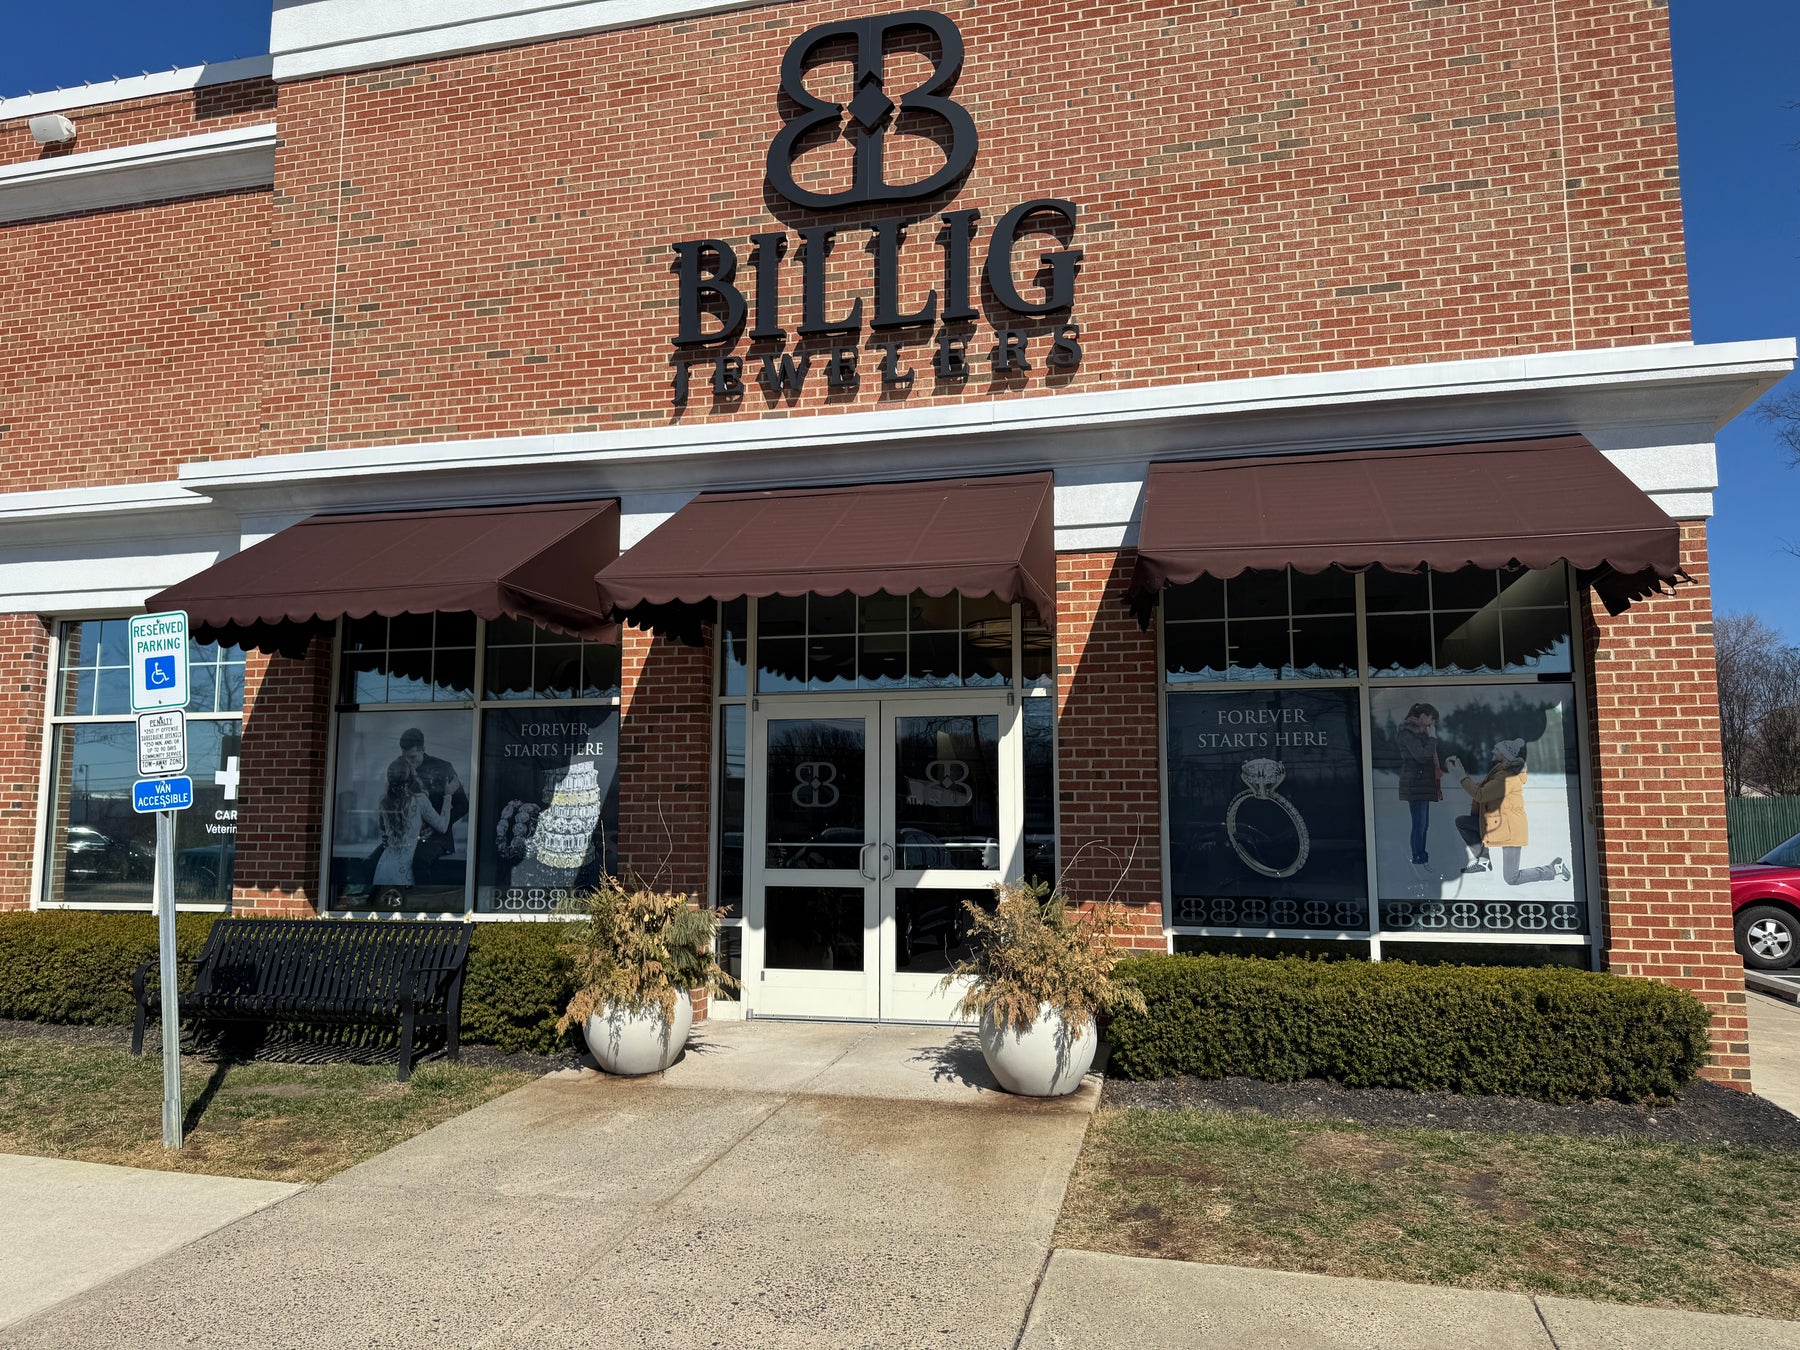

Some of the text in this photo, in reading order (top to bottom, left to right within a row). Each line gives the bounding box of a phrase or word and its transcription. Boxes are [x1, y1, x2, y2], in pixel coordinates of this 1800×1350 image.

[672, 199, 1084, 346] BILLIG
[672, 325, 1083, 406] JEWELERS
[134, 621, 183, 638] RESERVED
[137, 637, 181, 653] PARKING
[150, 718, 172, 727] PENALTY
[1217, 708, 1309, 724] FOREVER
[521, 723, 590, 736] FOREVER
[1198, 731, 1328, 748] STARTS HERE
[504, 742, 604, 757] STARTS HERE
[155, 783, 171, 794] VAN
[138, 793, 189, 807] ACCESSIBLE
